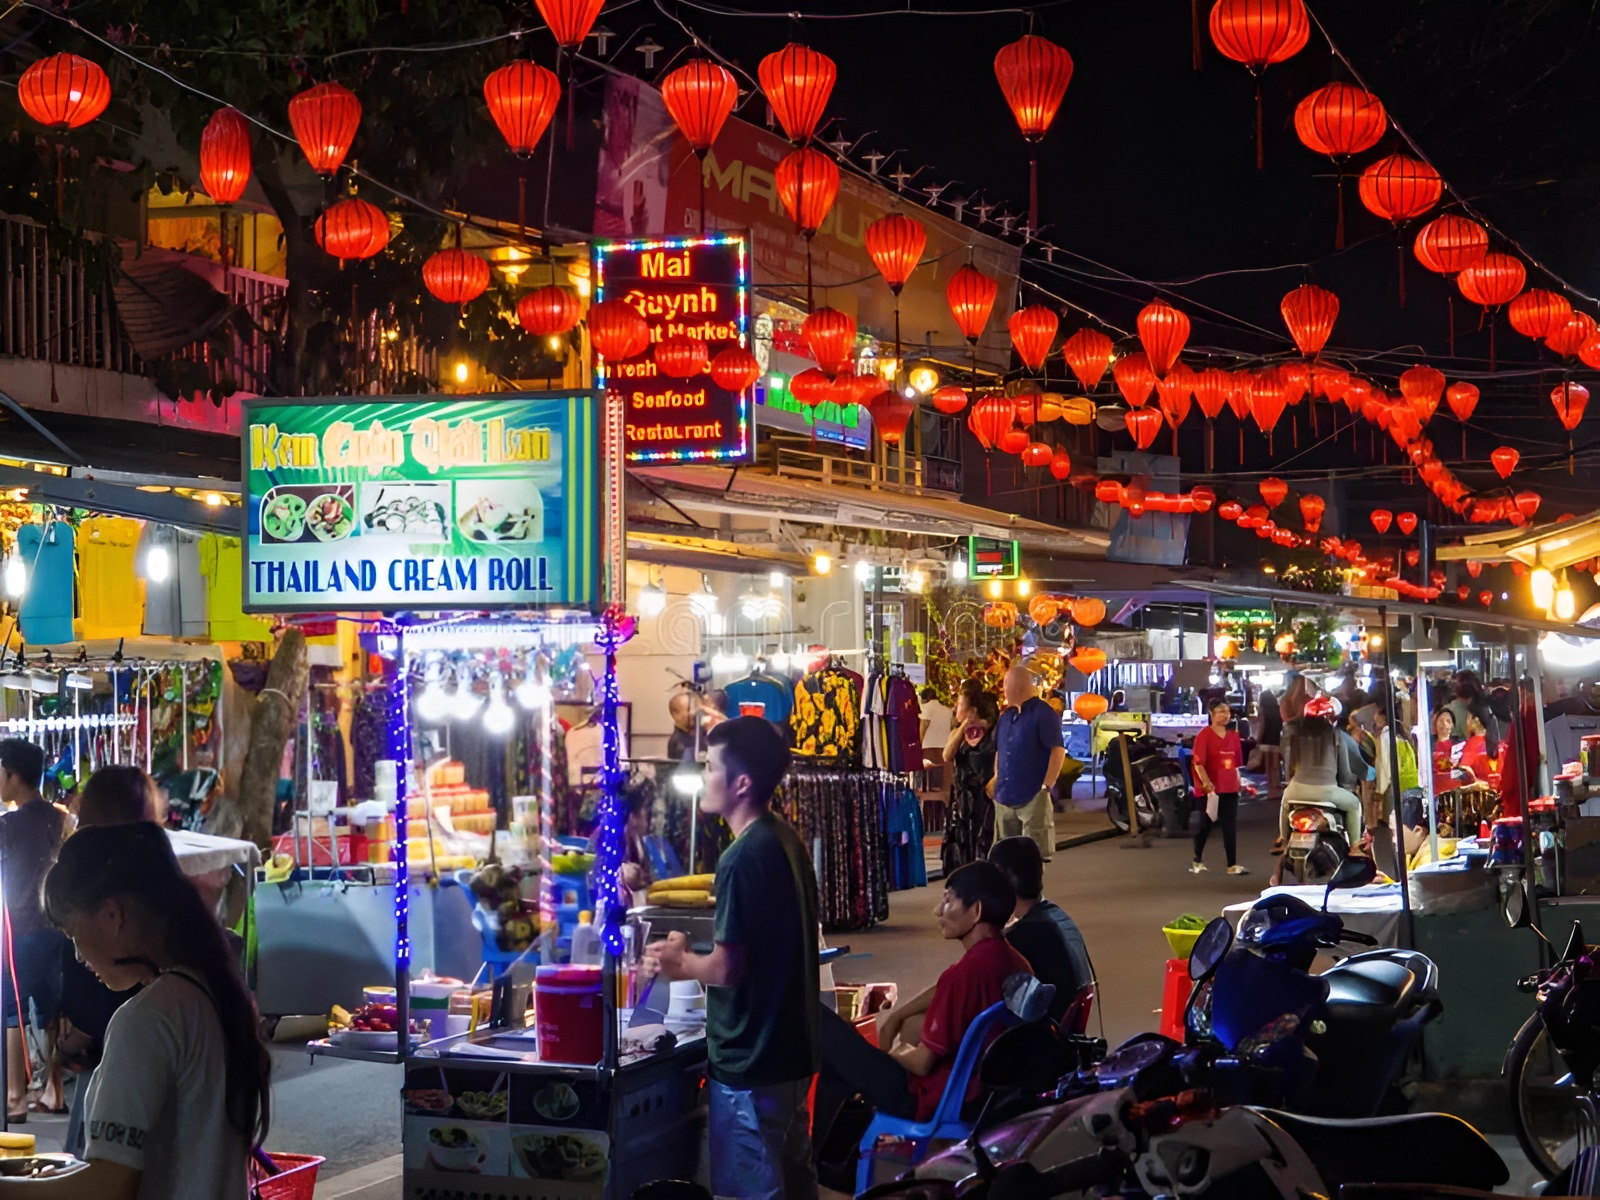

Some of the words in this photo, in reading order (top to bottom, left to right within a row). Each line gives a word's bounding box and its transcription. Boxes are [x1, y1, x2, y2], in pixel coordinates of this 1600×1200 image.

[640, 251, 691, 278] Mai
[632, 389, 706, 409] Seafood
[626, 420, 722, 441] Restaurant
[250, 559, 377, 593] THAILAND
[388, 557, 477, 592] CREAM
[488, 557, 554, 591] ROLL
